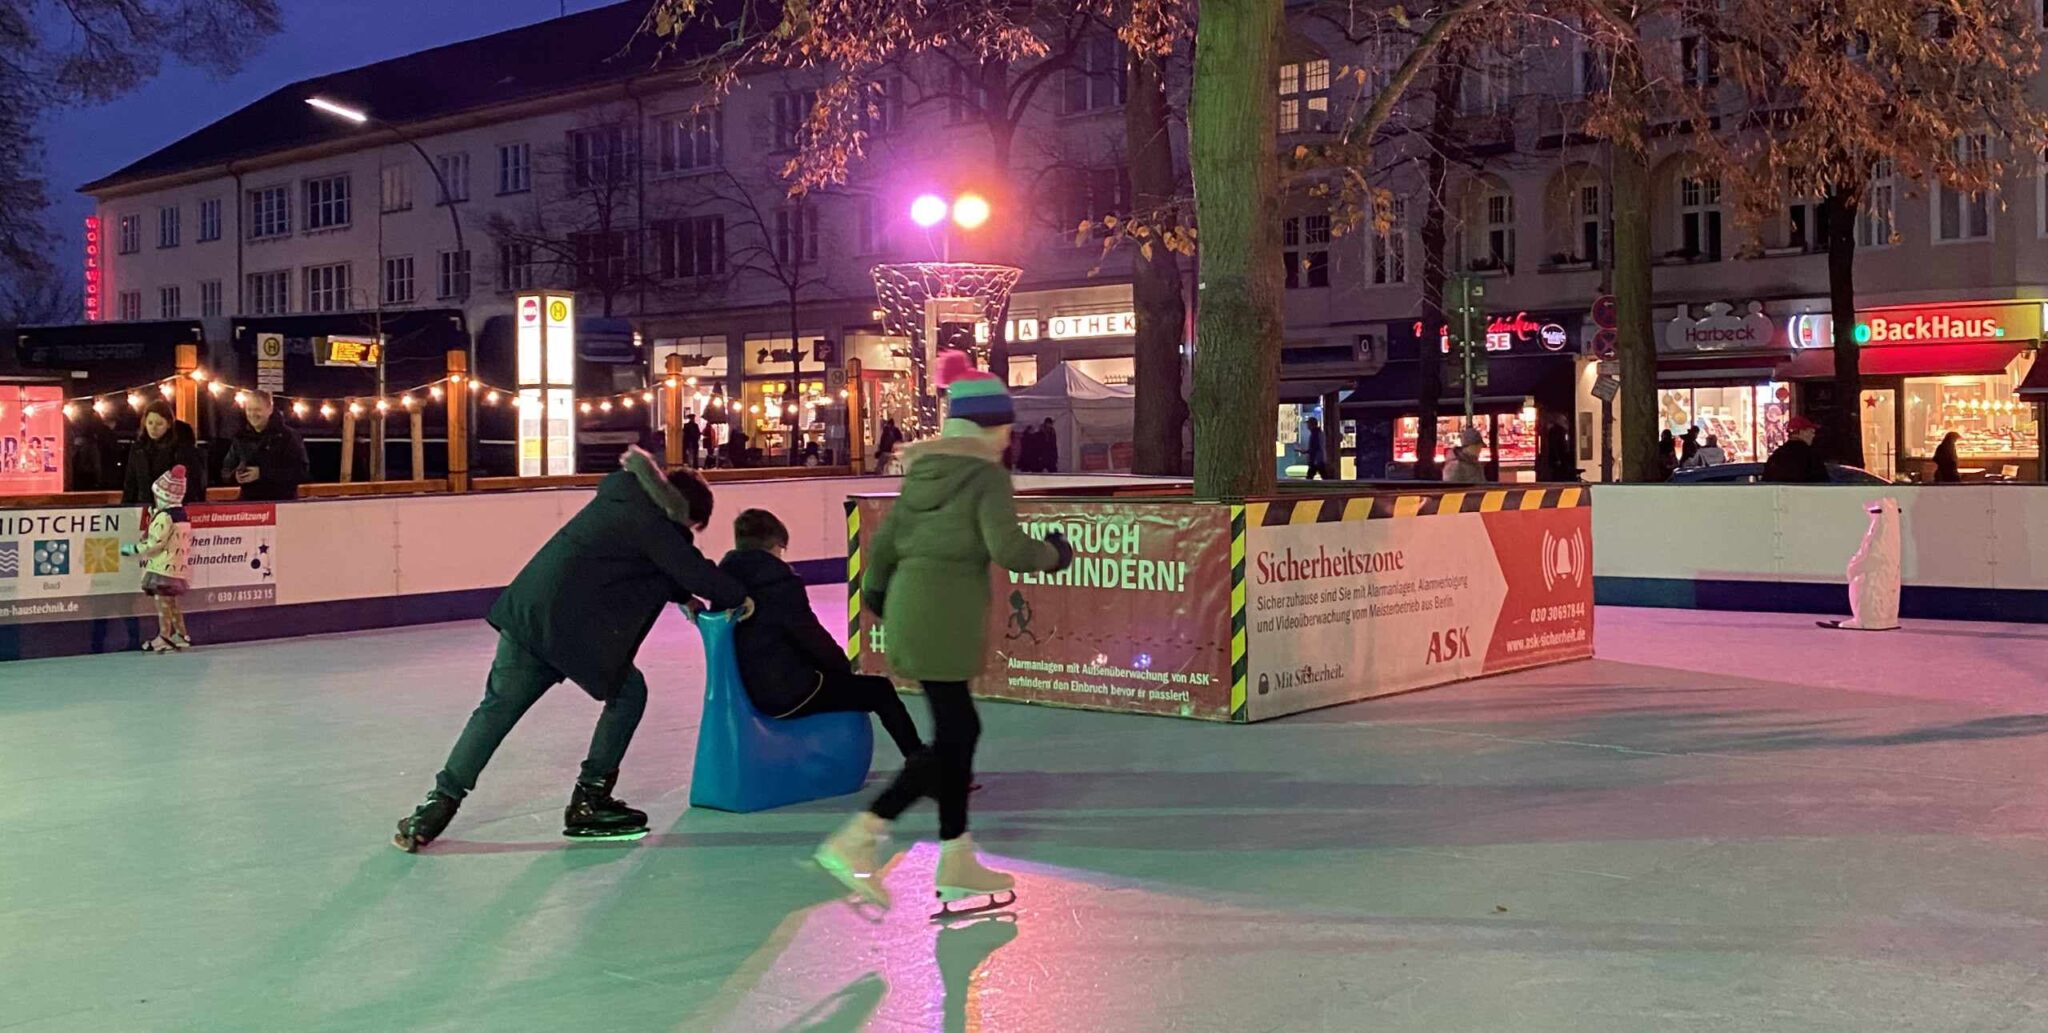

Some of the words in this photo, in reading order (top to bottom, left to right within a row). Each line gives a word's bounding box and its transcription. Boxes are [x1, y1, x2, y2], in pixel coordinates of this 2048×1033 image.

[85, 216, 99, 321] WOOLWORT
[1022, 316, 1135, 338] APOTHEK
[1685, 327, 1755, 342] Harbeck
[0, 514, 119, 536] IDTCHEN
[212, 511, 269, 523] Unterstützung!
[191, 536, 210, 547] hen
[213, 535, 242, 546] Ihnen
[1018, 522, 1140, 554] NRUCH
[187, 552, 248, 566] eihnachten!
[1257, 544, 1404, 585] Sicherheitszone
[43, 581, 61, 590] Bad
[218, 591, 232, 602] 030
[1320, 588, 1337, 603] sind
[1338, 587, 1351, 601] Sie
[1353, 584, 1366, 599] mit
[1257, 615, 1274, 633] und
[1276, 609, 1351, 631] Videoüberwachung
[1352, 608, 1367, 620] vom
[1369, 598, 1420, 618] Meisterbetrieb
[1421, 600, 1433, 612] aus
[1531, 607, 1547, 623] 030
[1426, 626, 1471, 665] ASK
[1506, 628, 1586, 653] www.ask-sicherheit.de
[1008, 658, 1063, 674] Alarmanlagen
[1066, 663, 1080, 673] mit
[1082, 664, 1168, 684] Außenüberwachung
[1172, 673, 1187, 683] von
[1189, 673, 1209, 685] ASK
[1274, 671, 1293, 690] Mit
[1294, 663, 1344, 687] Sicherheit.
[1008, 676, 1051, 689] verhindern
[1053, 680, 1069, 690] den
[1071, 681, 1108, 695] Einbruch
[1111, 684, 1134, 696] bevor
[1137, 688, 1146, 698] er
[1149, 689, 1189, 702] passiert!
